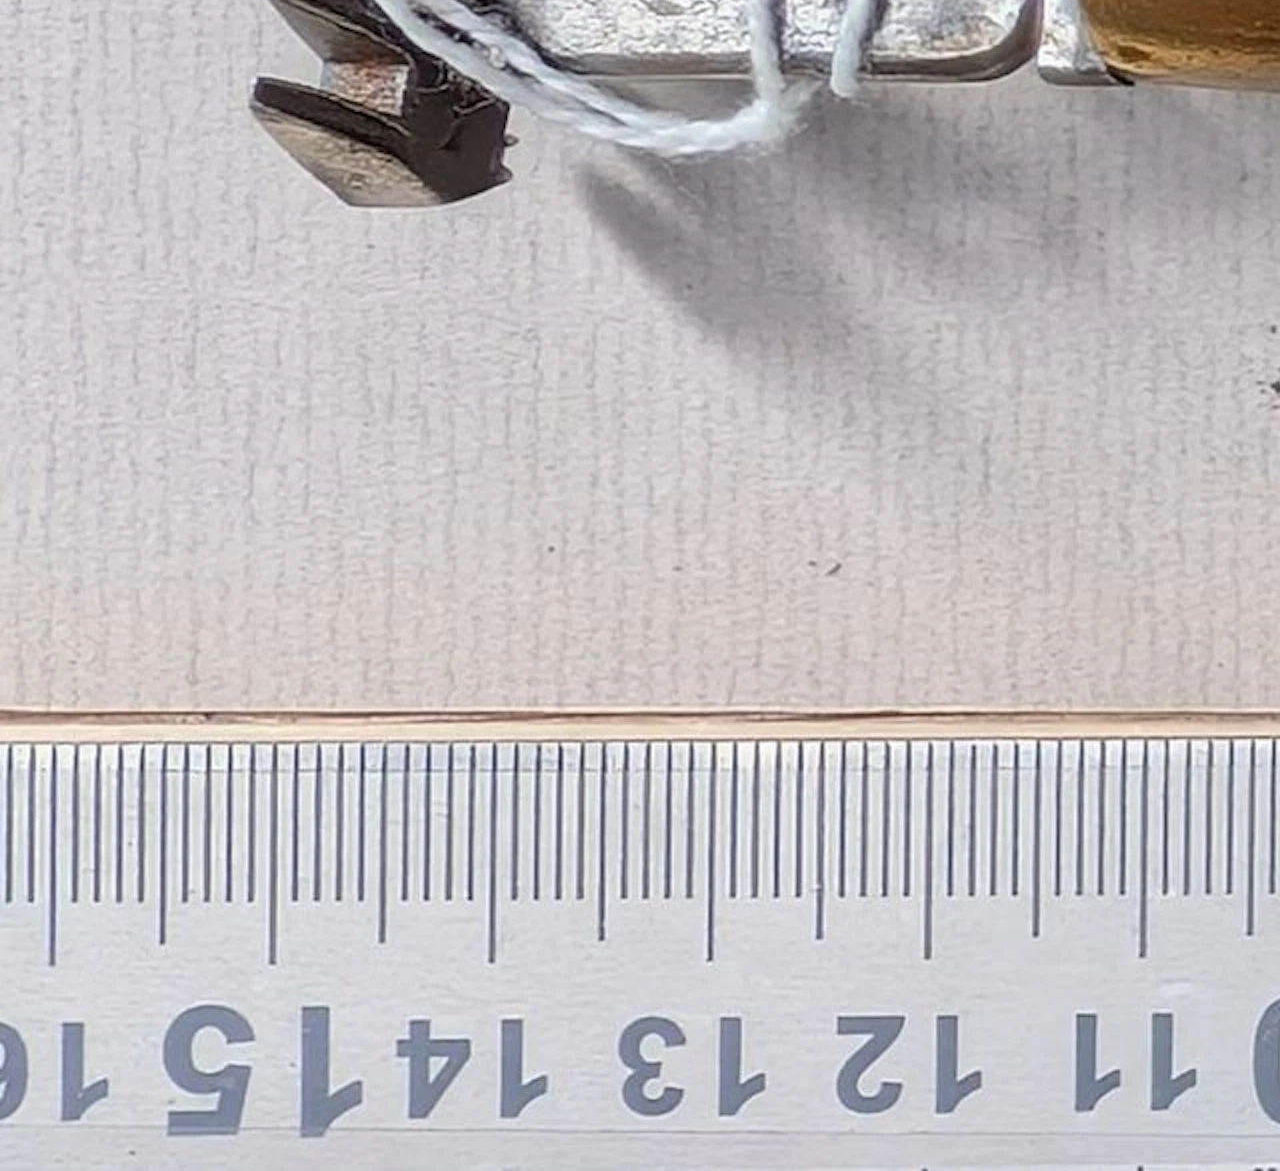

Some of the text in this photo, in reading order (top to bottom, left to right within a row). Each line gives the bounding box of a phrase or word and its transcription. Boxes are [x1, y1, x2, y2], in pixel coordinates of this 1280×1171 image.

[162, 1004, 363, 1138] 15
[396, 1019, 548, 1119] 14
[619, 1016, 766, 1117] 13
[836, 1015, 982, 1114] 12
[1074, 1013, 1197, 1112] 11
